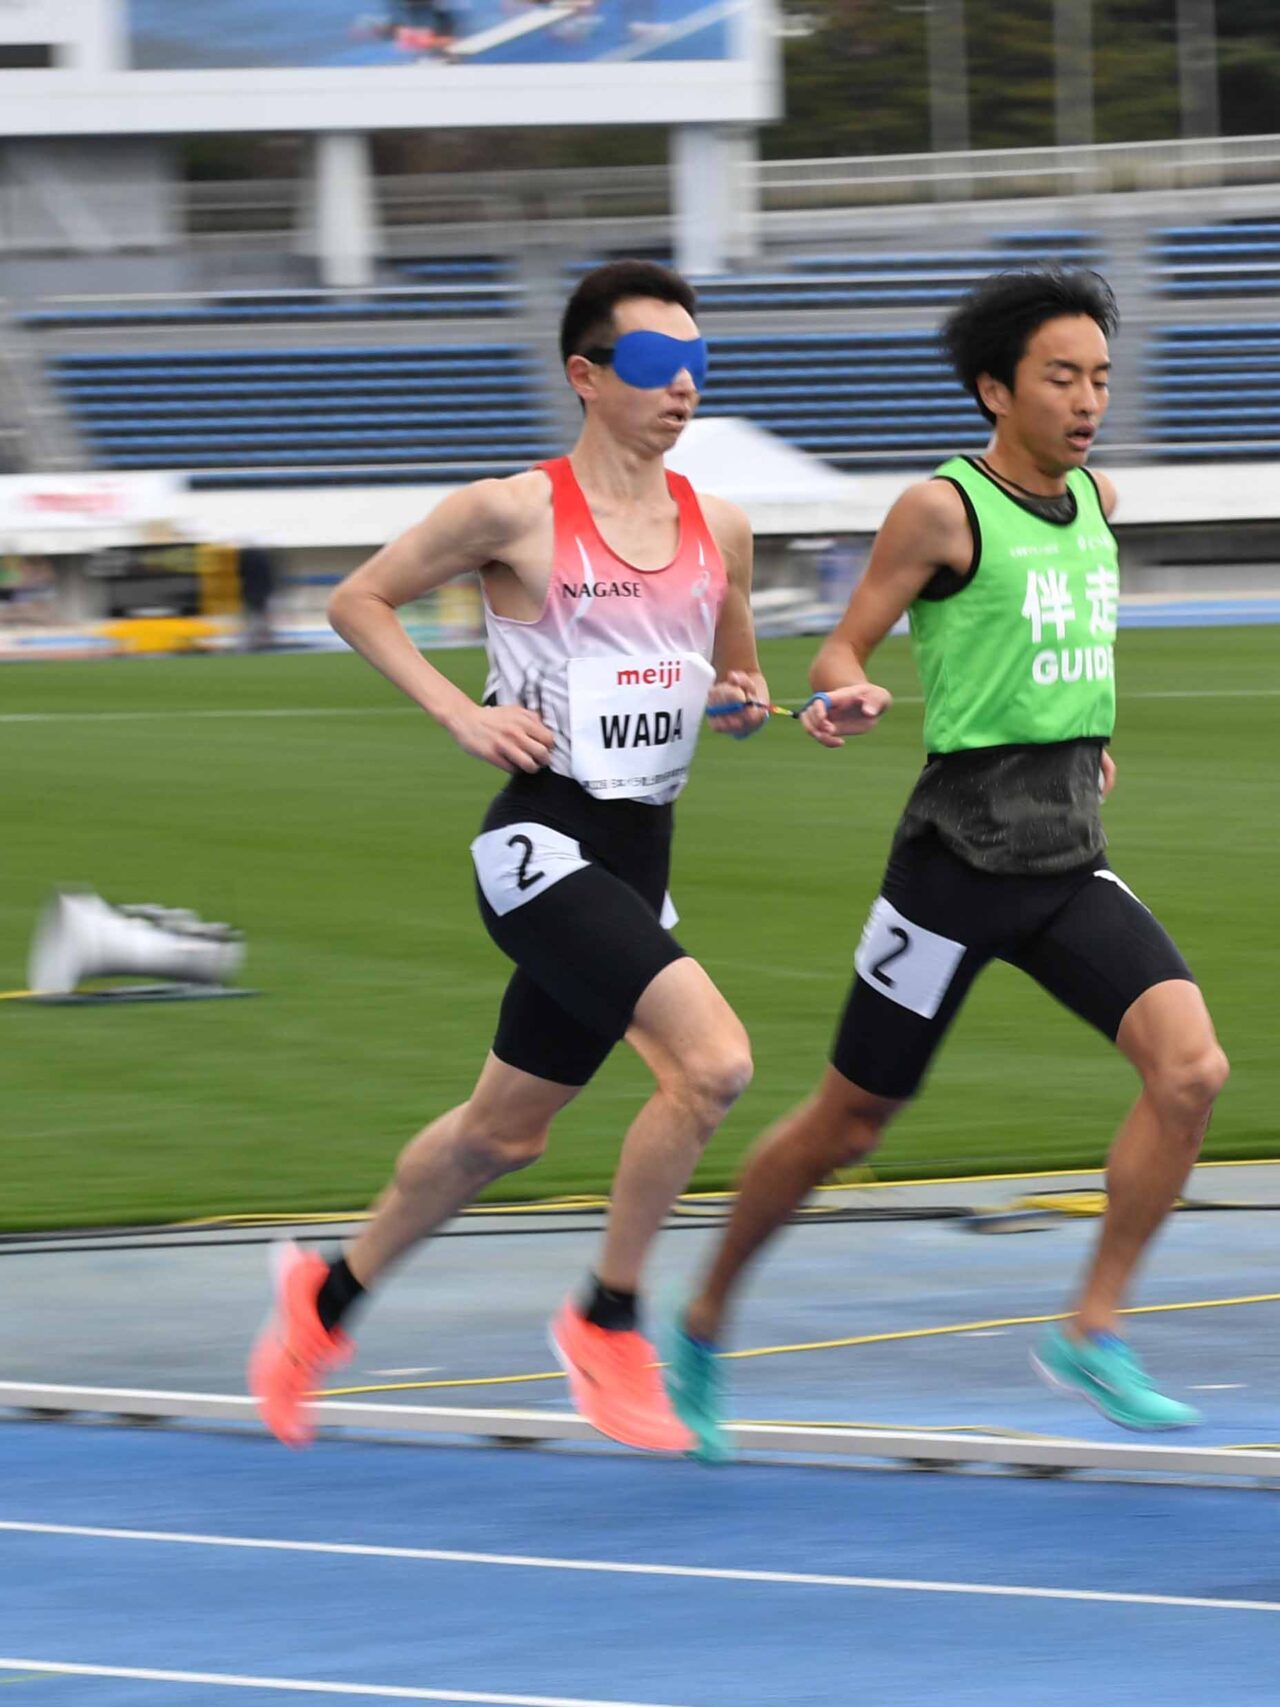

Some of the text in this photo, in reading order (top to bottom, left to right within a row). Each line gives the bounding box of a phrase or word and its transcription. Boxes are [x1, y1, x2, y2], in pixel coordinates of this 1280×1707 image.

[562, 582, 642, 598] NAGASE
[617, 661, 681, 688] meiji
[600, 708, 682, 749] WADA
[508, 834, 545, 891] 2
[871, 927, 910, 988] 2
